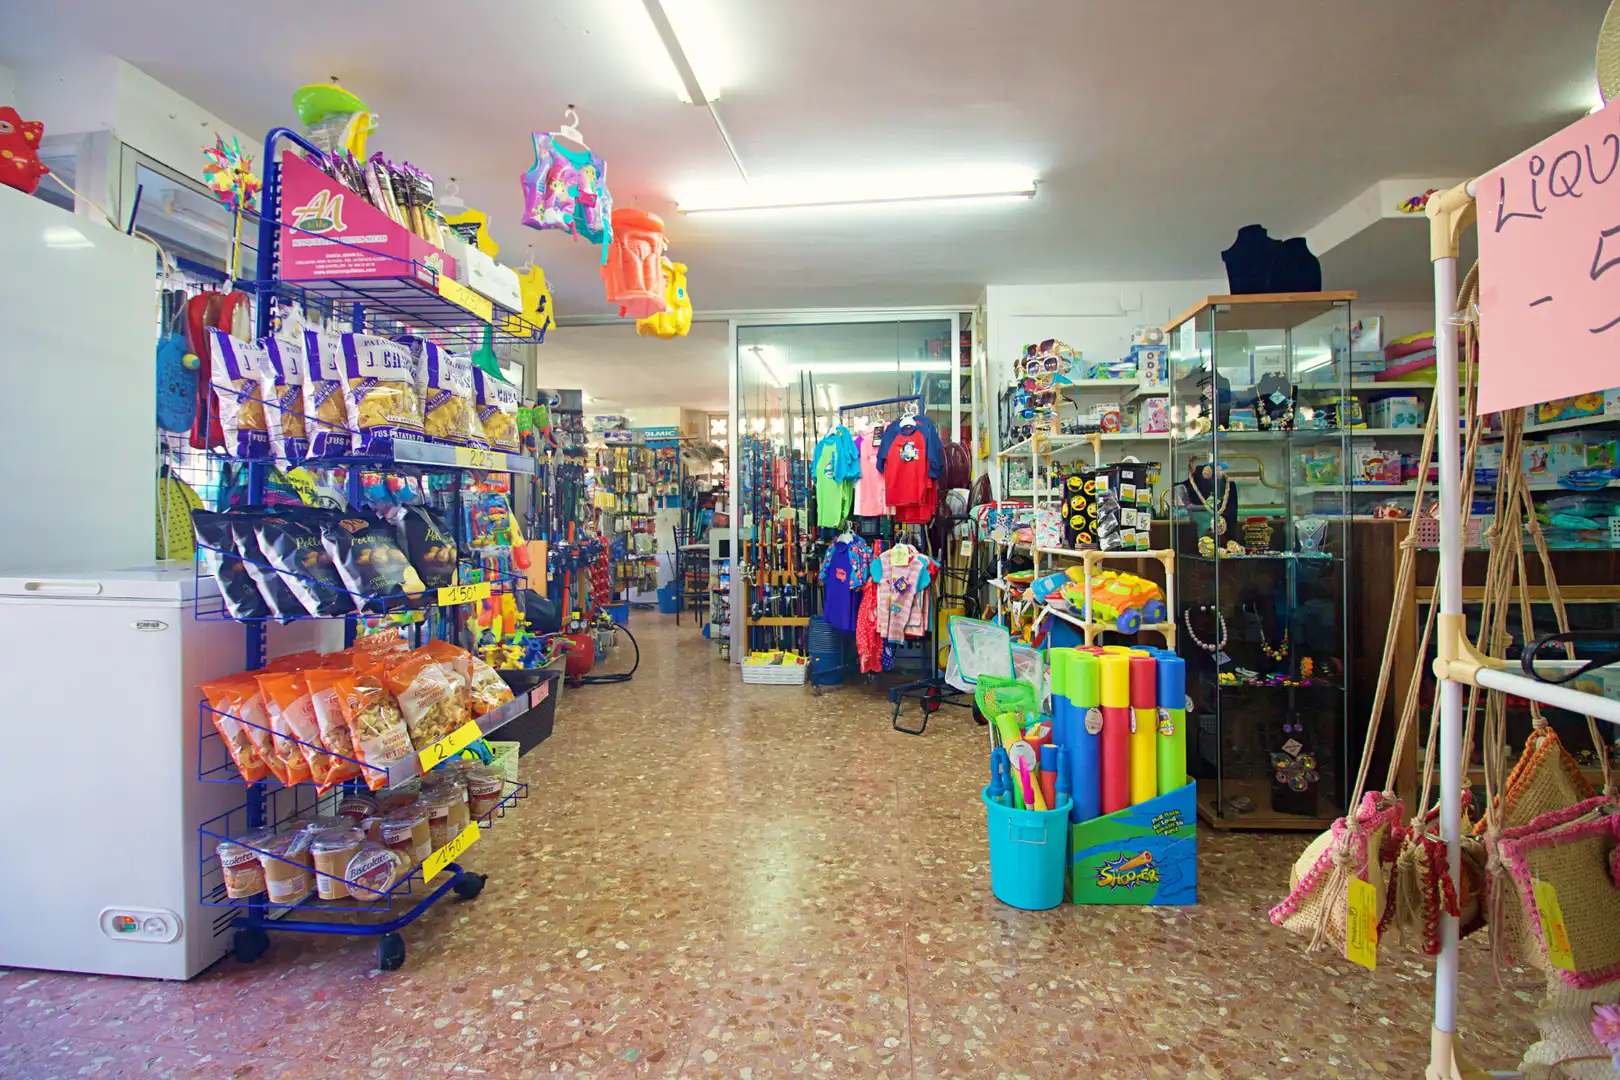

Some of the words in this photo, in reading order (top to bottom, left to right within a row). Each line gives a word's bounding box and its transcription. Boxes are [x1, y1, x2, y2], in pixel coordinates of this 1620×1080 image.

[329, 437, 345, 445] TUS
[433, 743, 448, 760] 2
[350, 852, 390, 878] Biscolata
[1097, 865, 1160, 887] SHOOTER
